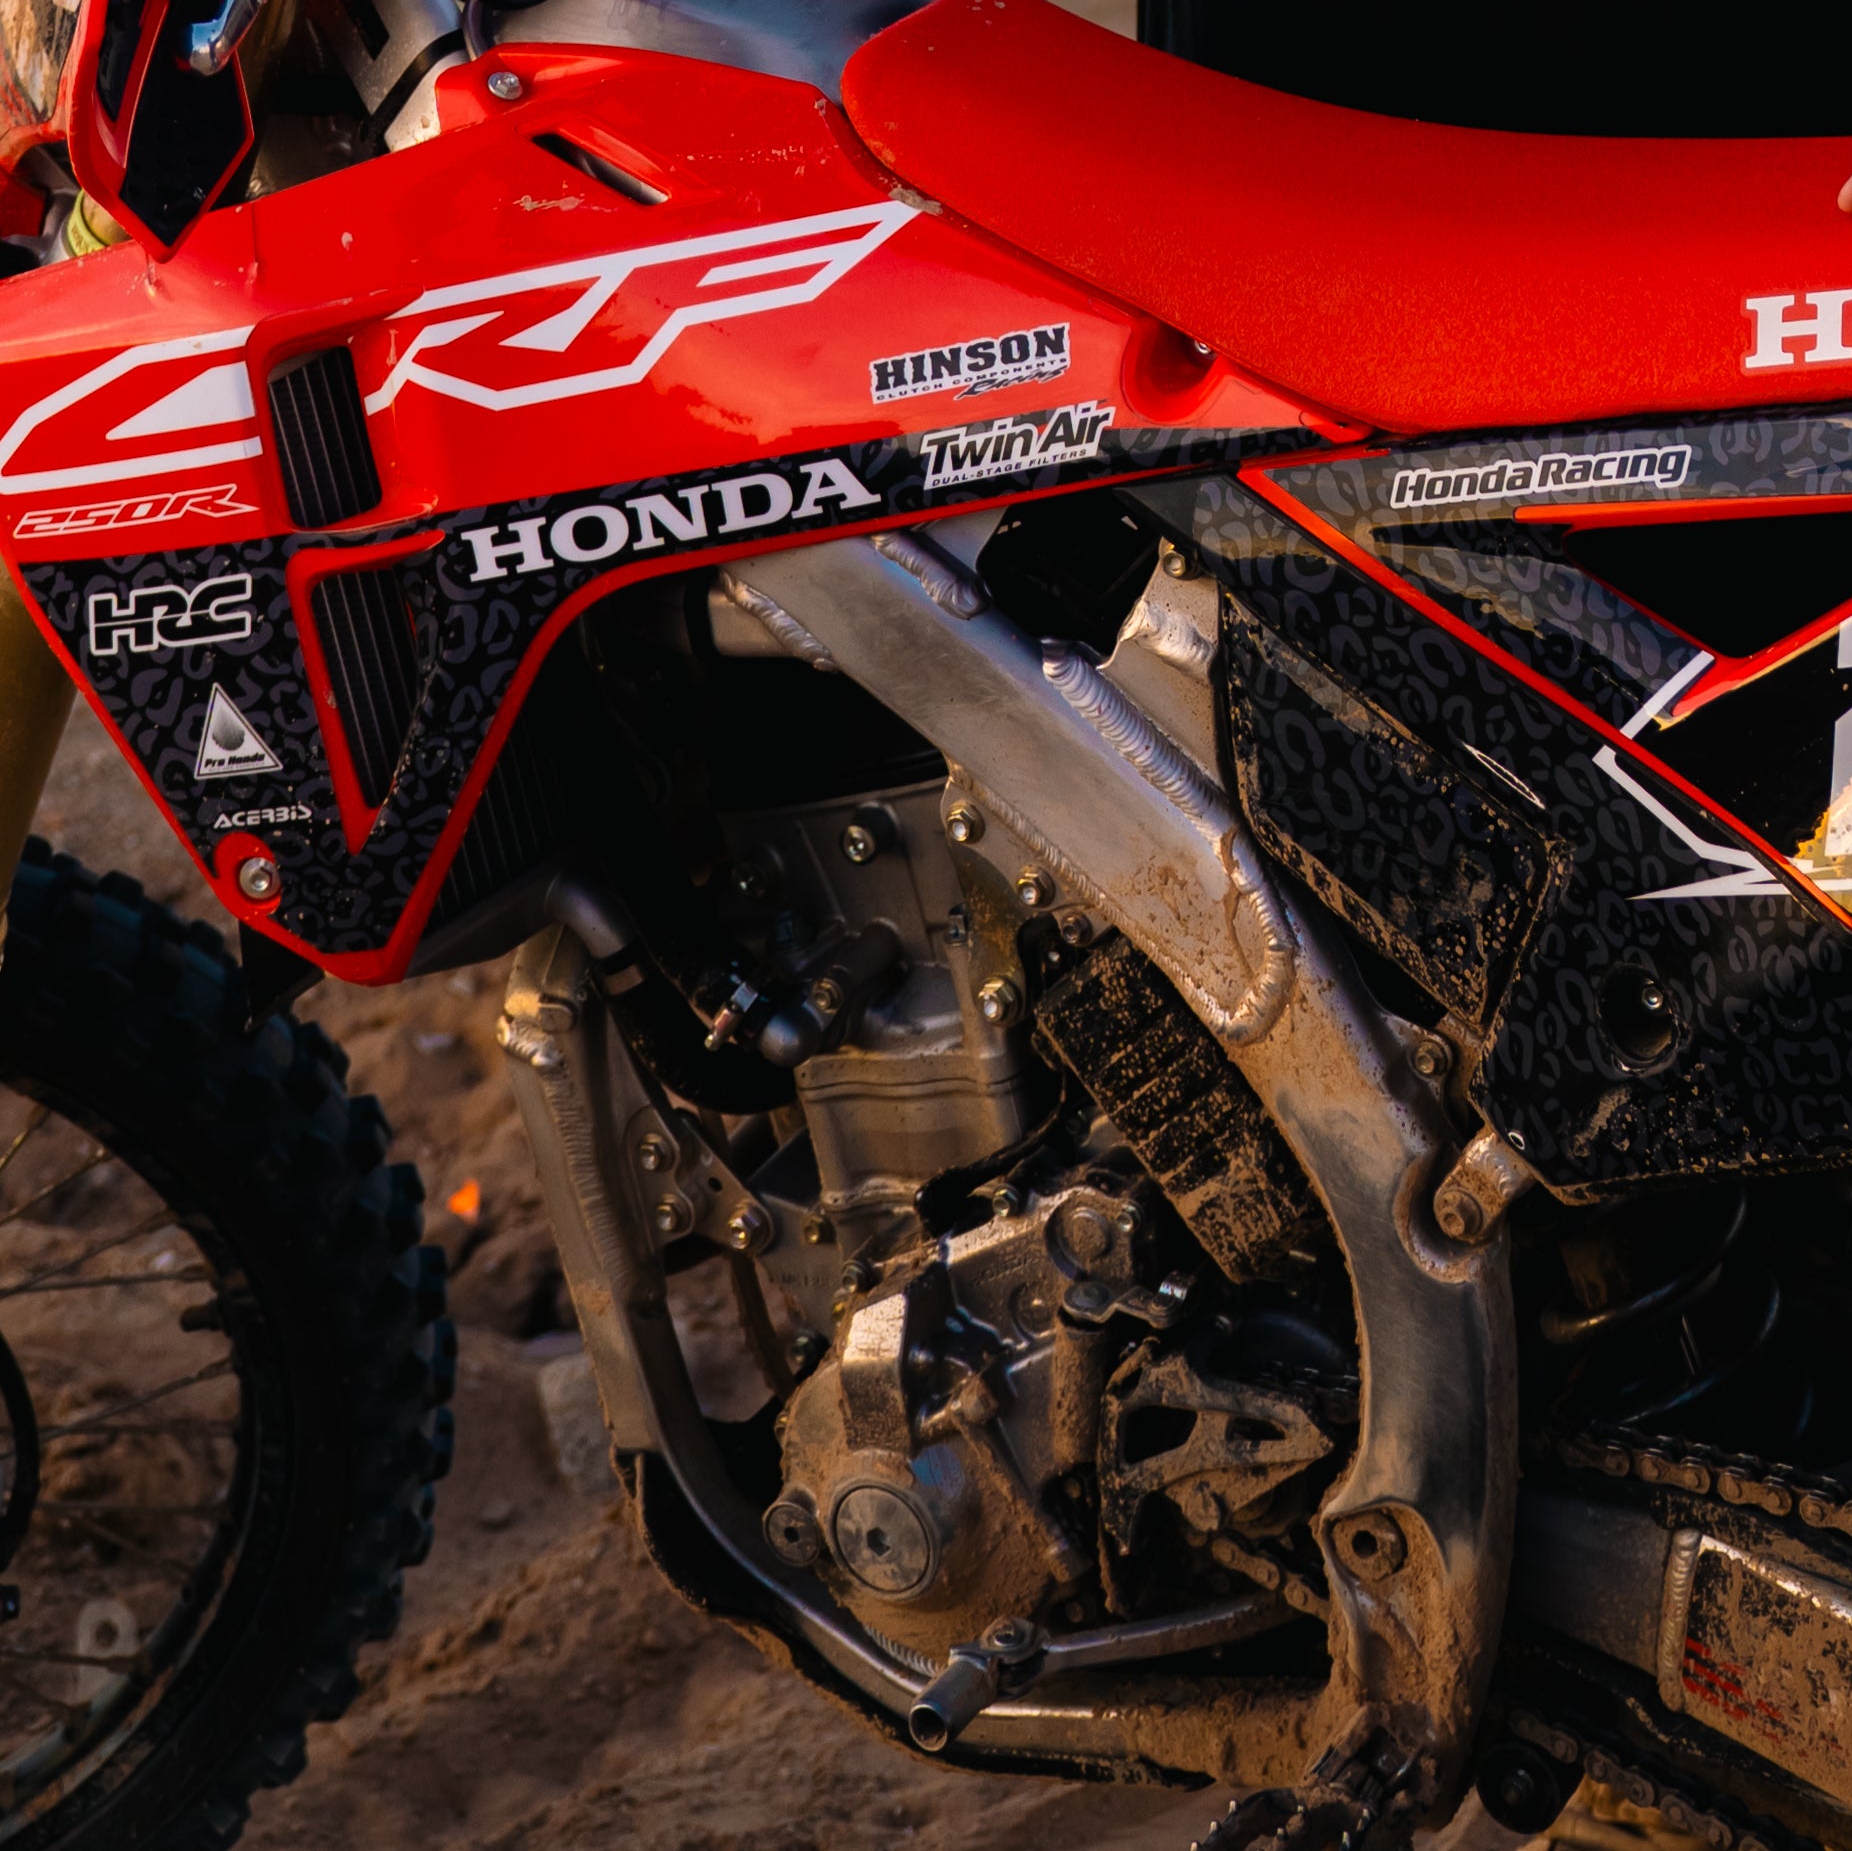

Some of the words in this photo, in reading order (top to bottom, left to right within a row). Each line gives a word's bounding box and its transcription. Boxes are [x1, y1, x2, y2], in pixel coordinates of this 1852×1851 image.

[0, 199, 923, 495] CRF
[872, 325, 1066, 392] HINSON
[876, 382, 943, 401] CLUTCH
[952, 357, 1068, 385] COMPONENTS
[926, 422, 1035, 476] Twin
[1038, 407, 1112, 454] Air
[932, 462, 1022, 487] DUAL-STAGE
[1028, 448, 1088, 467] FILTERS
[1394, 465, 1533, 504] Honda
[1537, 449, 1688, 488] Racing
[13, 483, 260, 538] 250R
[460, 458, 881, 583] HONDA
[88, 572, 252, 656] HRC
[213, 803, 312, 829] ACERBIS
